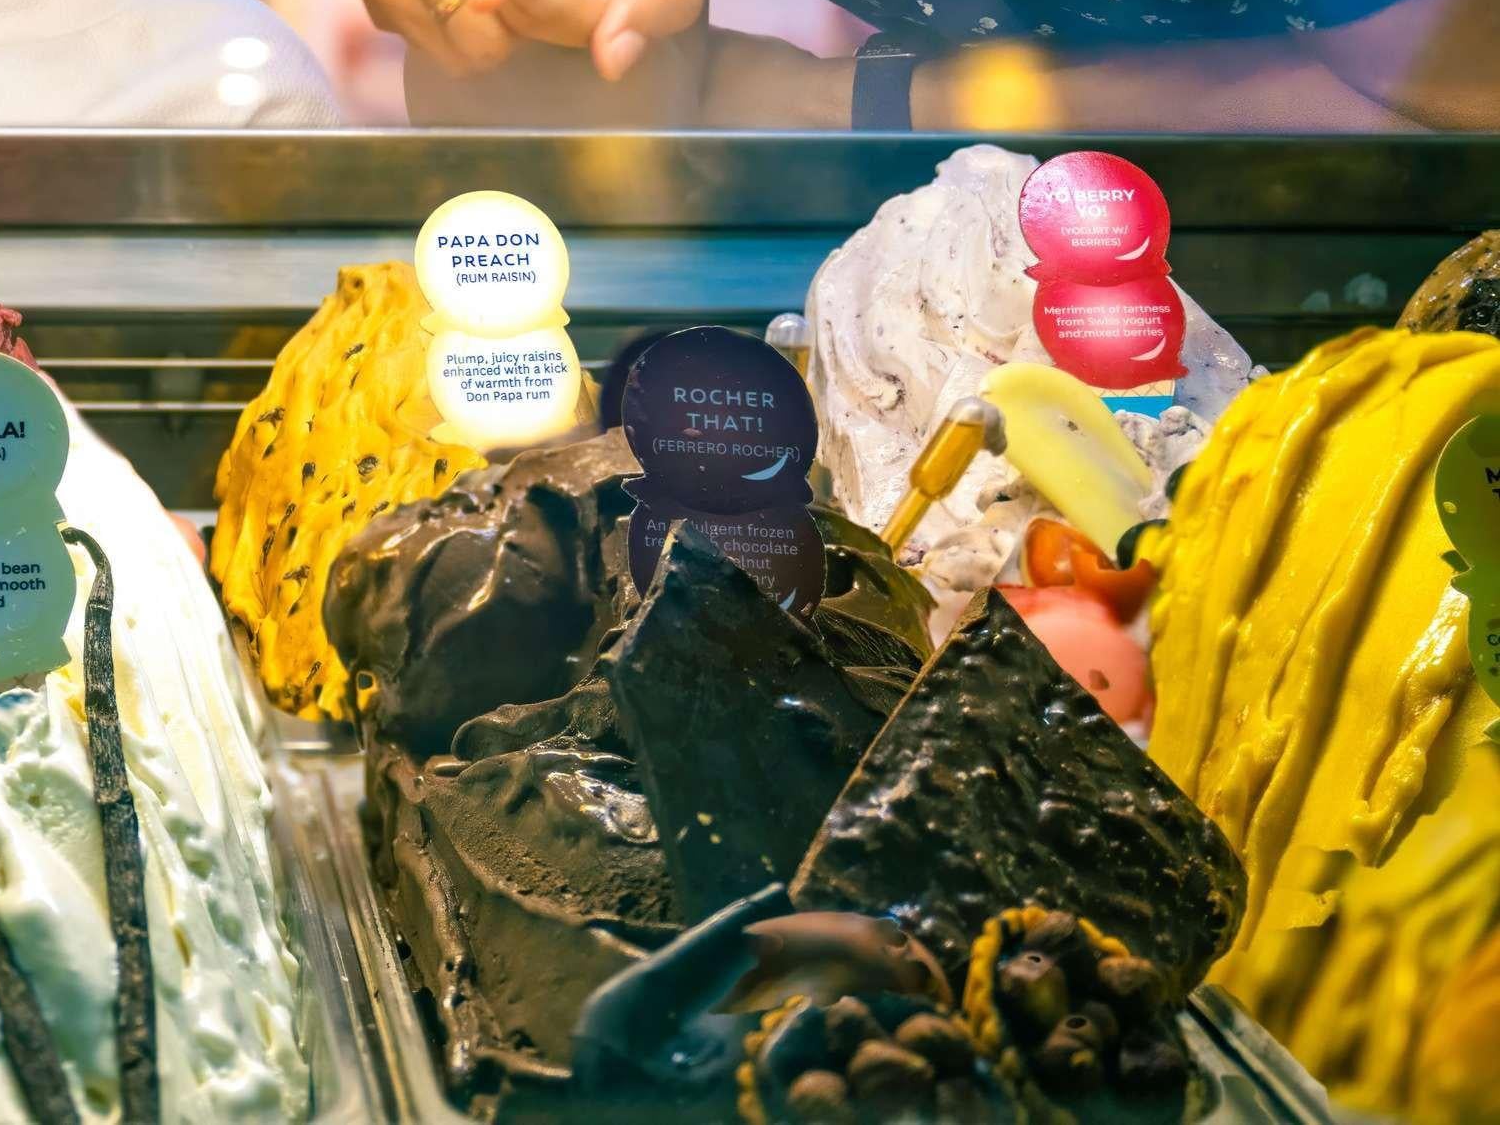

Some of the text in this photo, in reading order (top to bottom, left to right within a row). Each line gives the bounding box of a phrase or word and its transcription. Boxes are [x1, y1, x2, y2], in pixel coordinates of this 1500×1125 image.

[1075, 189, 1135, 202] BERRY
[1077, 205, 1107, 219] YO!
[438, 233, 540, 248] PAPA DON
[452, 253, 530, 268] PREACH
[456, 272, 536, 286] (RUM RAISIN)
[1124, 305, 1171, 314] tartness
[1056, 316, 1084, 326] from
[1124, 316, 1162, 327] yogurt
[1124, 328, 1163, 337] berries
[447, 350, 562, 366] Plump, juicy raisins
[443, 362, 568, 377] enhanced with a kick
[461, 376, 553, 390] of warmth from
[466, 390, 550, 403] Don Papa rum
[674, 387, 774, 408] ROCHER
[686, 412, 763, 433] THAT!
[653, 440, 800, 462] (FERRERO ROCHER)
[646, 519, 666, 532] An
[748, 524, 794, 539] frozen
[723, 539, 798, 555] chocolate
[2, 562, 40, 575] bean
